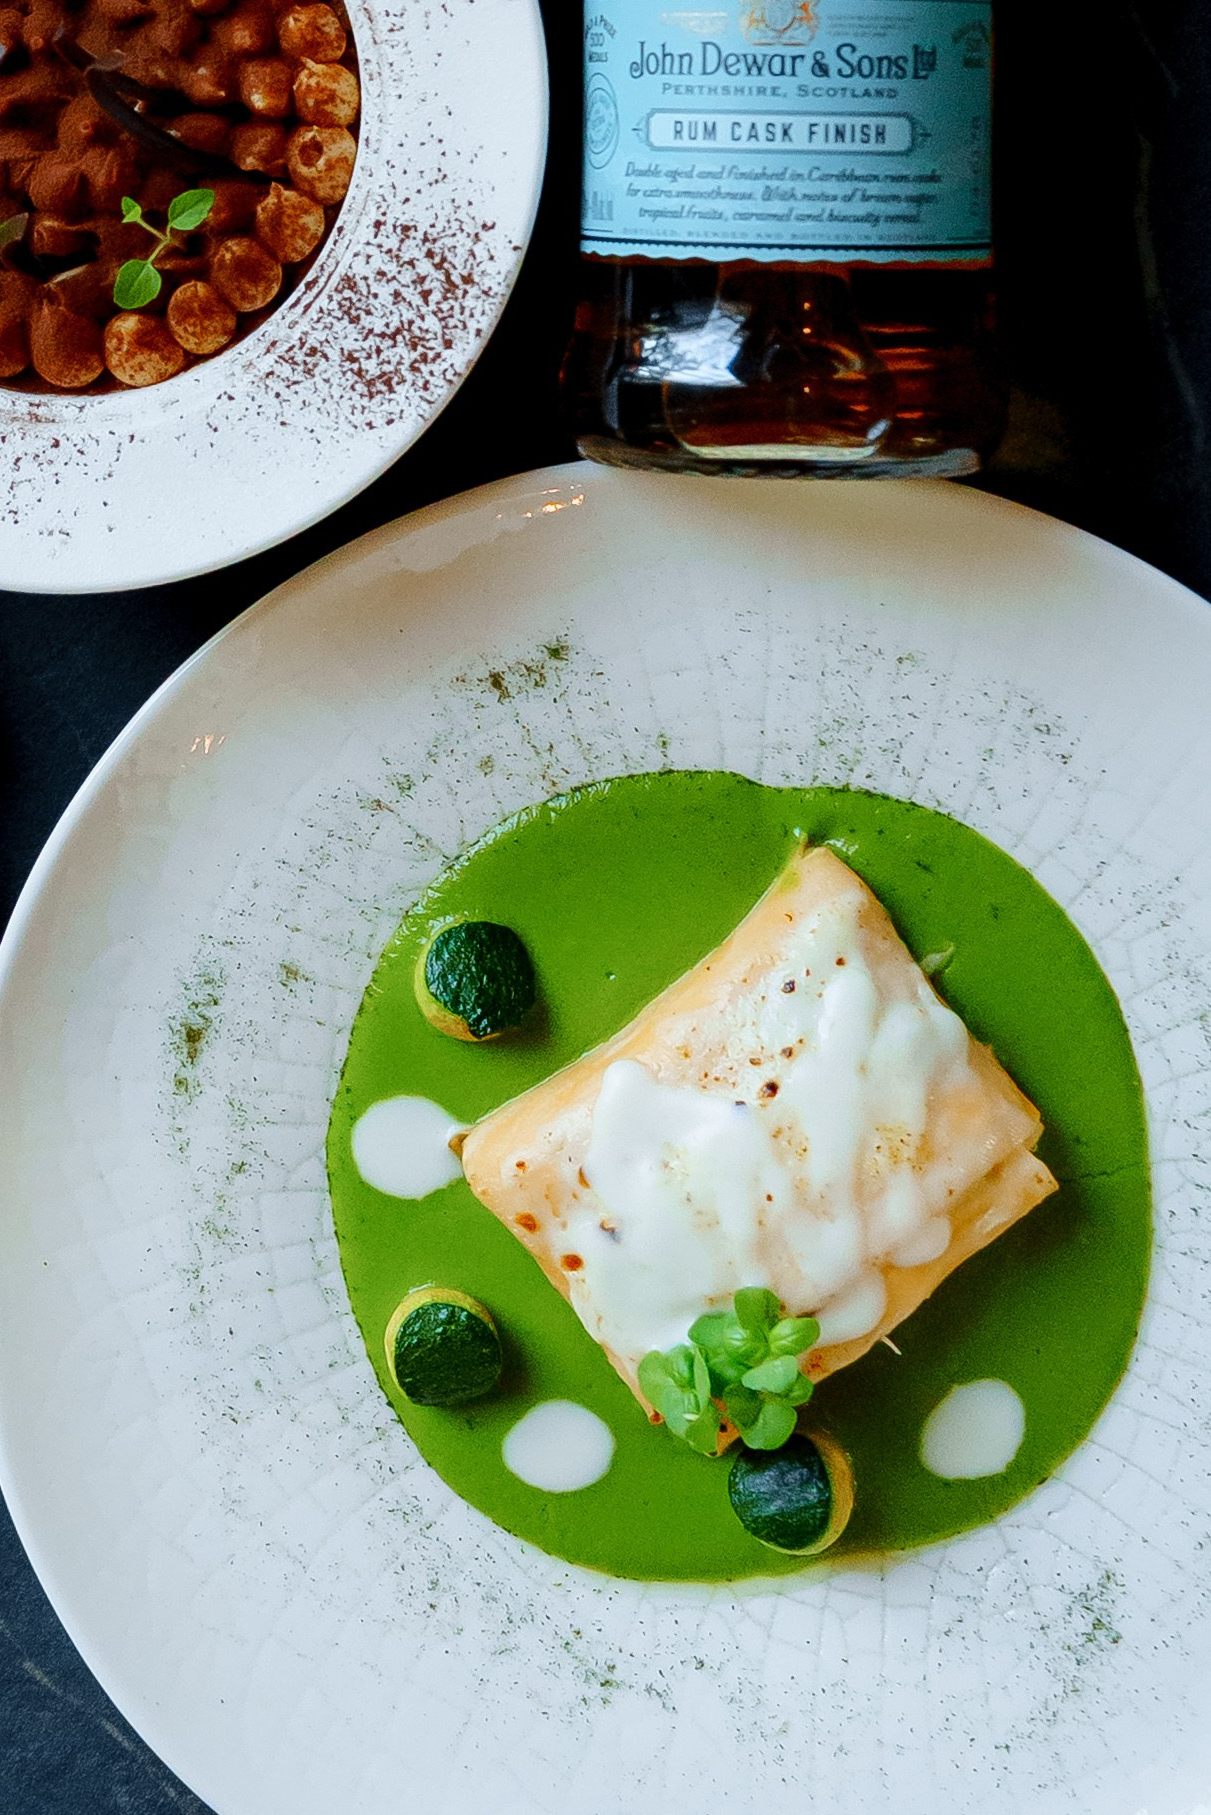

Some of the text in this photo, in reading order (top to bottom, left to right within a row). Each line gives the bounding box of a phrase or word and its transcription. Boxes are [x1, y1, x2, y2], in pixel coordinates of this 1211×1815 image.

[629, 41, 693, 79] John
[701, 41, 805, 78] Dewar
[811, 50, 830, 78] &
[836, 42, 909, 80] Sons
[662, 82, 899, 99] PERTHSHIRE, SCOTLAND
[674, 120, 887, 144] RUM CASK FINISH
[696, 165, 726, 180] and
